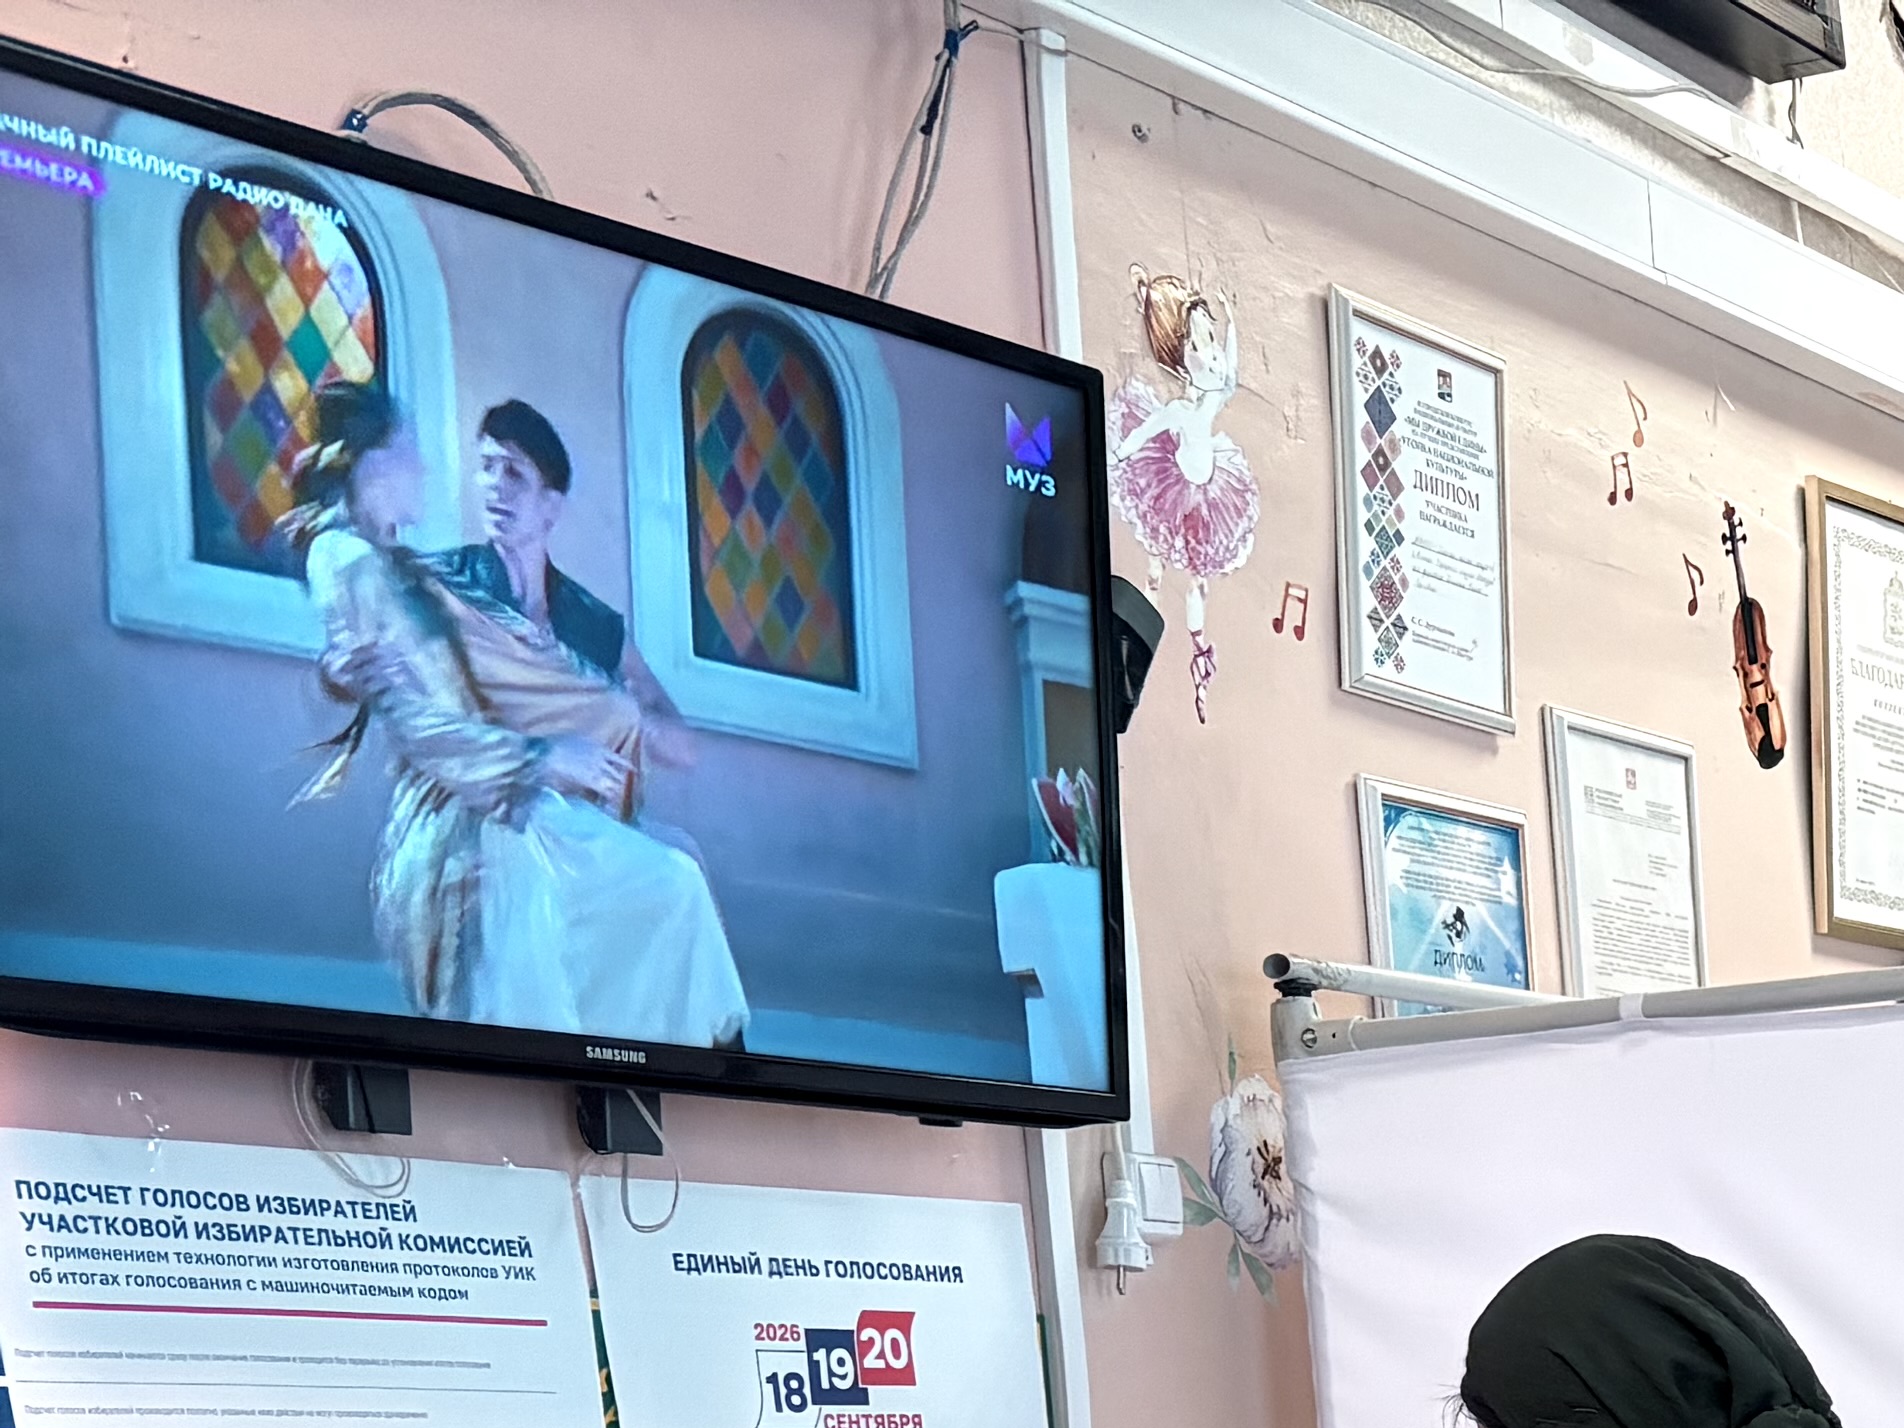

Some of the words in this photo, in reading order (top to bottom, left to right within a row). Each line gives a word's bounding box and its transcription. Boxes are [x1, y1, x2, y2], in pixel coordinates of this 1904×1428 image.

[81, 135, 202, 187] ПЛЕЙЛИСТ
[207, 172, 286, 210] РАДИО
[1005, 468, 1057, 497] МУЗ
[1413, 469, 1480, 512] ДИПЛОМ
[1434, 948, 1486, 973] ДИПЛОМ
[586, 1046, 647, 1064] SAMSUNG
[14, 1179, 133, 1208] ПОДСЧЕТ
[138, 1186, 253, 1214] ГОЛОСОВ
[256, 1195, 419, 1224] ИЗБИРАТЕЛЕЙ
[19, 1210, 189, 1240] УЧАСТКОВОЙ
[193, 1219, 394, 1252] ИЗБИРАТЕЛЬНОЙ
[398, 1230, 534, 1259] КОМИССИЕЙ
[25, 1245, 37, 1258] с
[41, 1246, 170, 1266] применением
[174, 1251, 279, 1271] технологии
[281, 1256, 399, 1276] изготовления
[402, 1262, 499, 1283] протоколов
[501, 1263, 537, 1282] УИК
[671, 1250, 763, 1278] ЕДИНЫЙ
[767, 1255, 821, 1281] ДЕНЬ
[823, 1259, 965, 1285] ГОЛОСОВАНИЯ
[29, 1269, 53, 1286] об
[57, 1272, 121, 1287] итогах
[125, 1275, 243, 1293] голосования
[246, 1279, 258, 1292] с
[260, 1280, 414, 1300] машиночитаемым
[417, 1286, 470, 1303] кодом
[753, 1322, 801, 1342] 2026
[765, 1370, 809, 1414] 18
[812, 1347, 855, 1392] 19
[858, 1326, 910, 1370] 20
